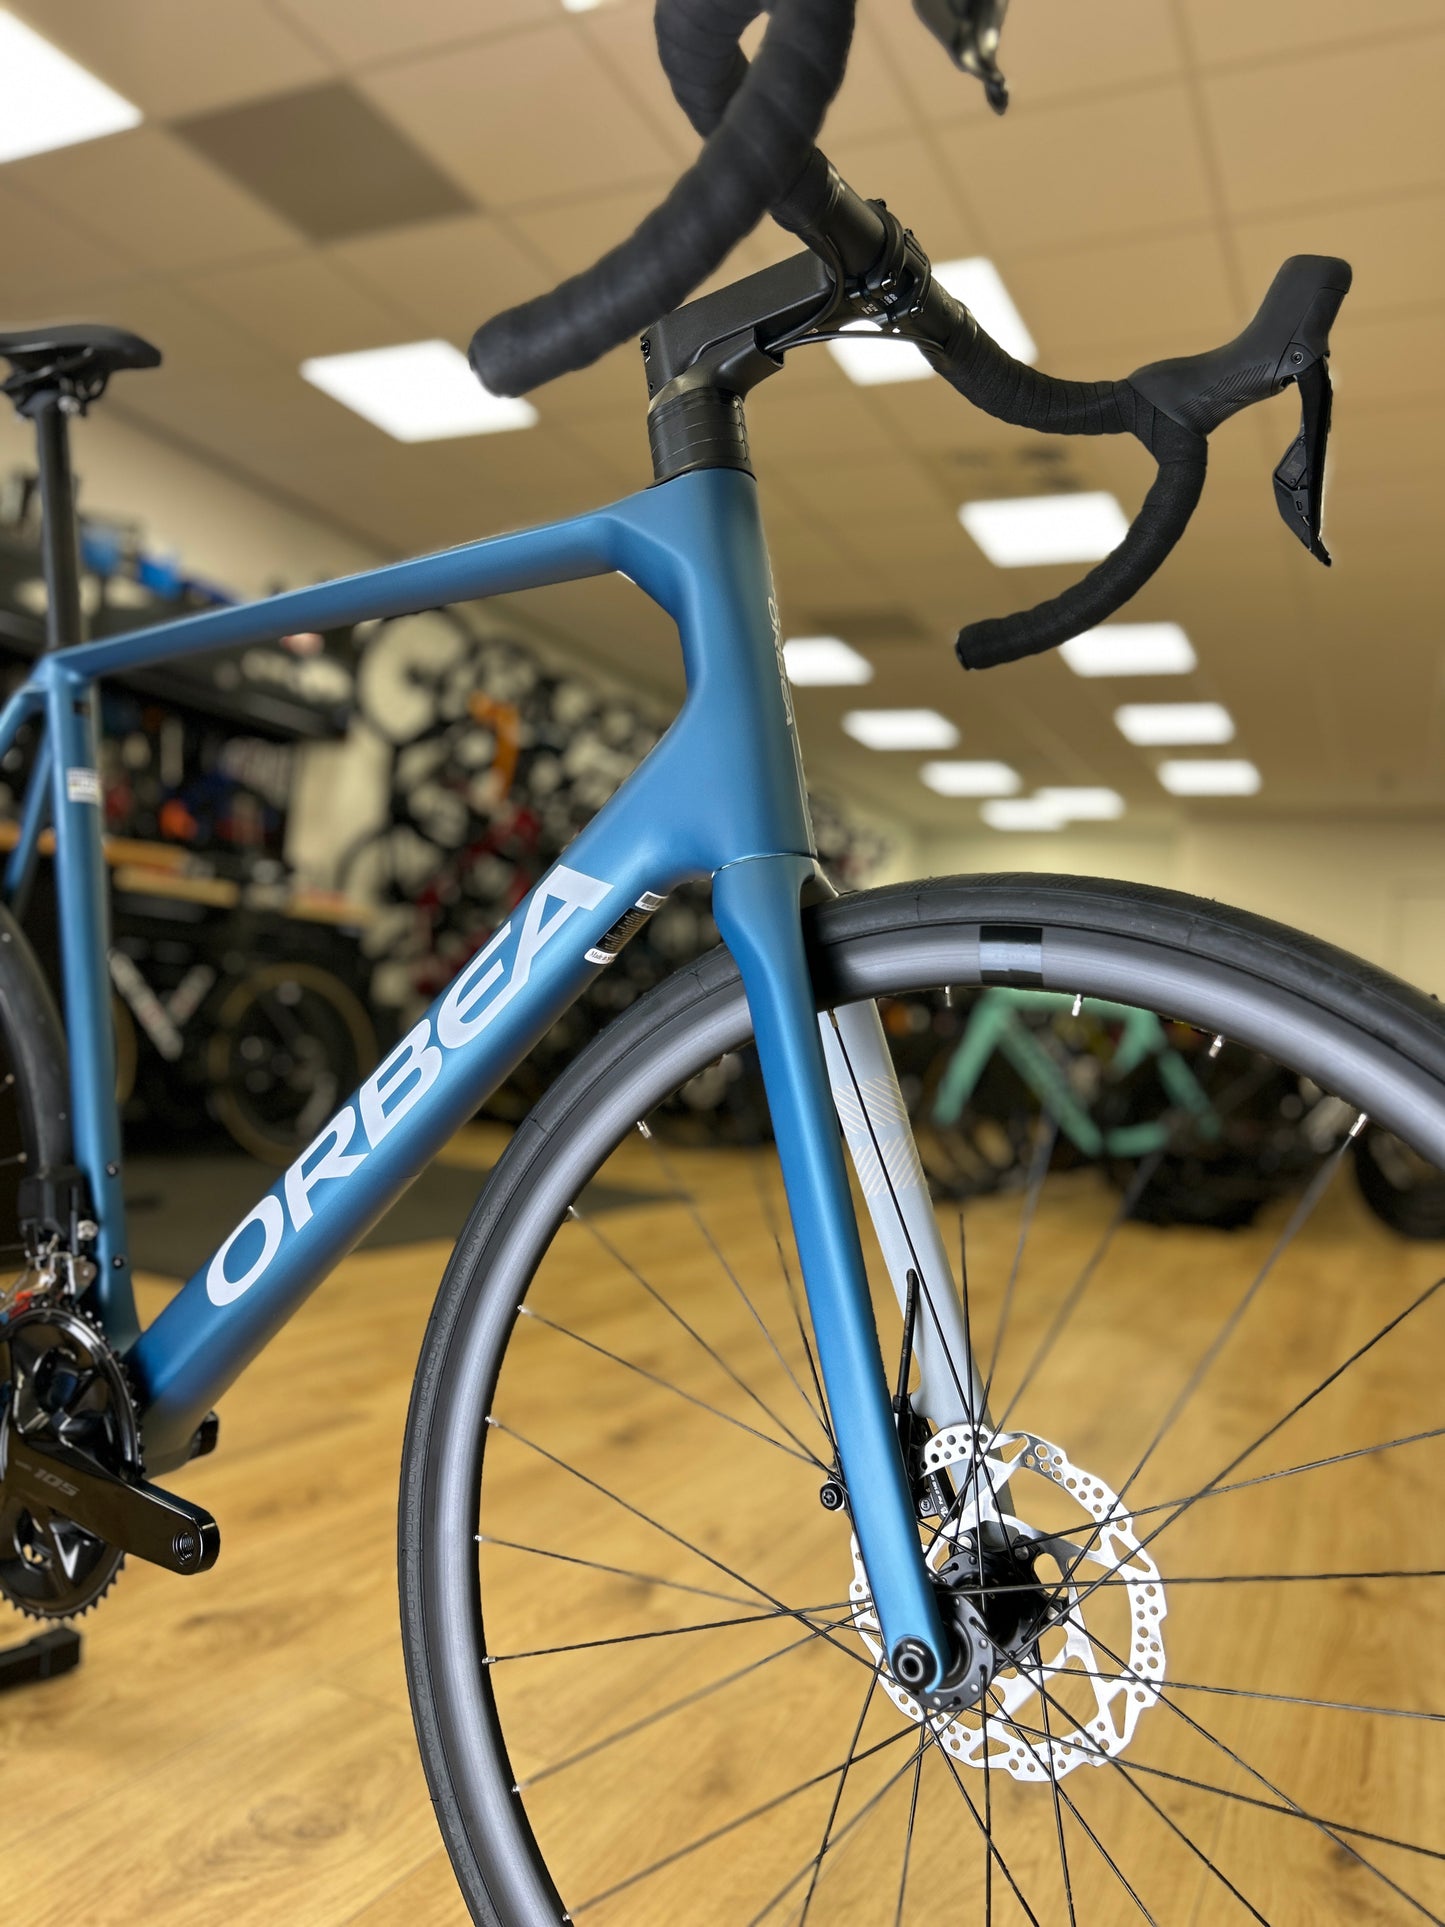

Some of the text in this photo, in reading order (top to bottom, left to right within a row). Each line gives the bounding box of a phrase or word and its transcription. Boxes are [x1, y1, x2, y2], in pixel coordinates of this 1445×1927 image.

[206, 864, 615, 1307] ORBEA
[445, 1232, 479, 1301] ROTATION
[33, 1467, 81, 1497] 105
[405, 1570, 415, 1593] PSI
[410, 1650, 424, 1685] BAR
